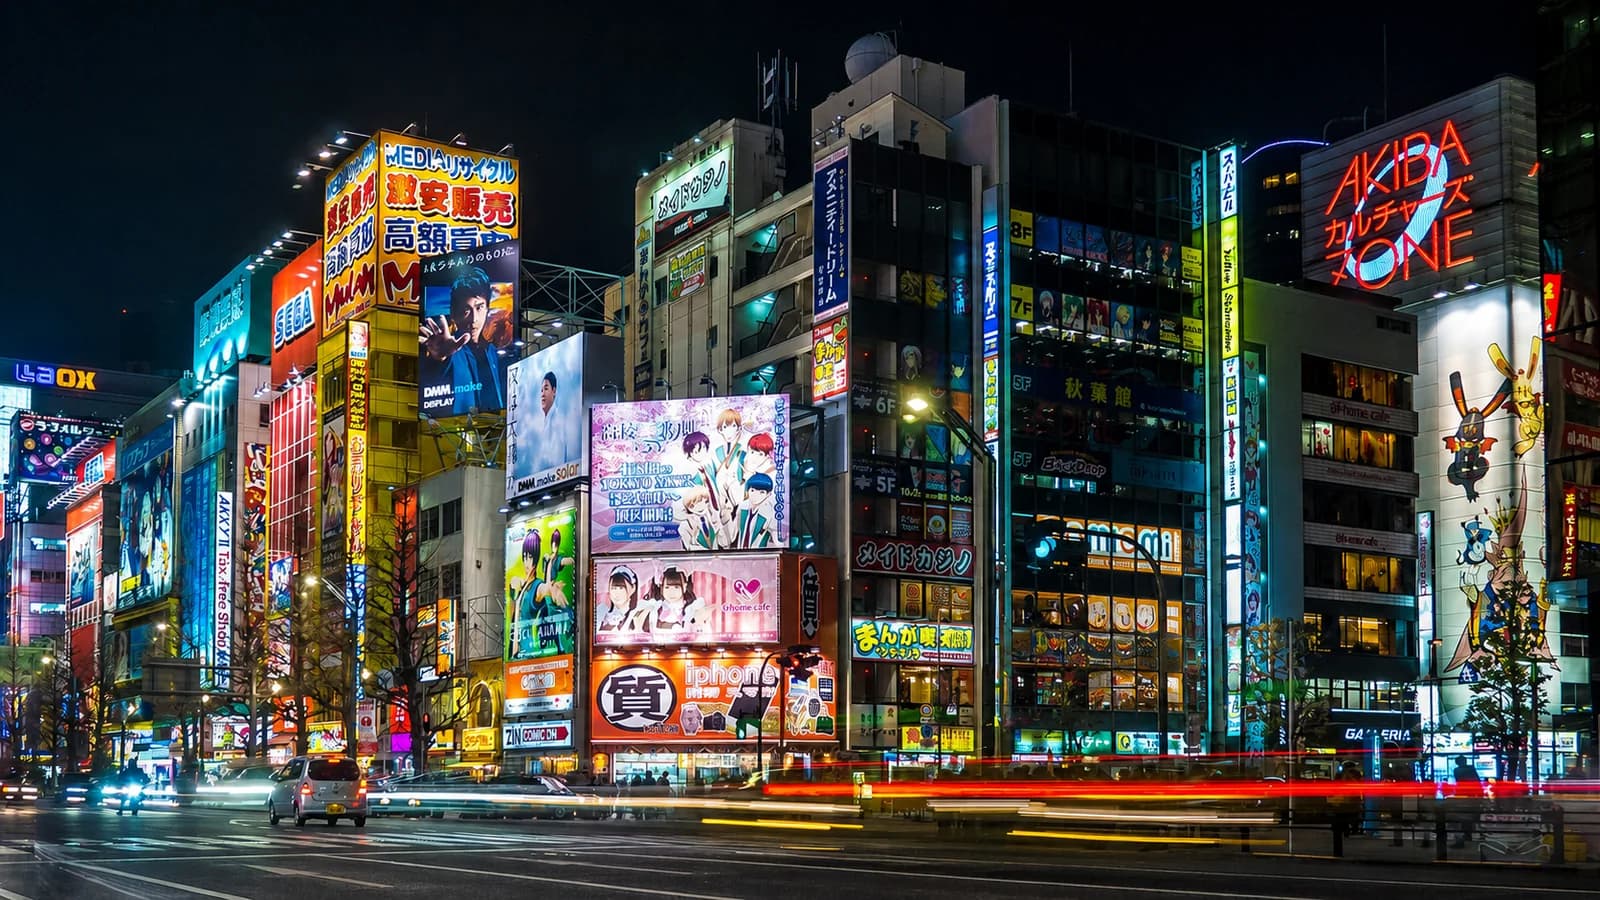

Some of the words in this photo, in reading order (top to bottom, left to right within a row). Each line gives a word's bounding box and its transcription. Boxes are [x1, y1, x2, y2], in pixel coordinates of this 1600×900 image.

[1325, 119, 1472, 215] AKIBA
[385, 173, 515, 226] 激安販売
[1324, 174, 1474, 248] カルチャーズ
[1010, 221, 1033, 241] 8F
[1324, 209, 1475, 290] ZONE
[1010, 297, 1033, 316] 7F
[274, 288, 315, 349] SEGA
[424, 380, 483, 398] DMM.make
[1065, 377, 1132, 409] 秋葉館
[424, 397, 454, 409] DISPLAY
[875, 397, 897, 415] 6F
[556, 463, 580, 481] solar
[876, 476, 897, 494] 5F
[218, 551, 230, 575] Tax
[857, 541, 973, 576] メイドカジノ
[753, 602, 771, 612] cafe
[685, 660, 778, 688] iphone
[606, 674, 667, 724] 質
[522, 727, 545, 742] COMIC
[1344, 727, 1412, 742] GAERIA
